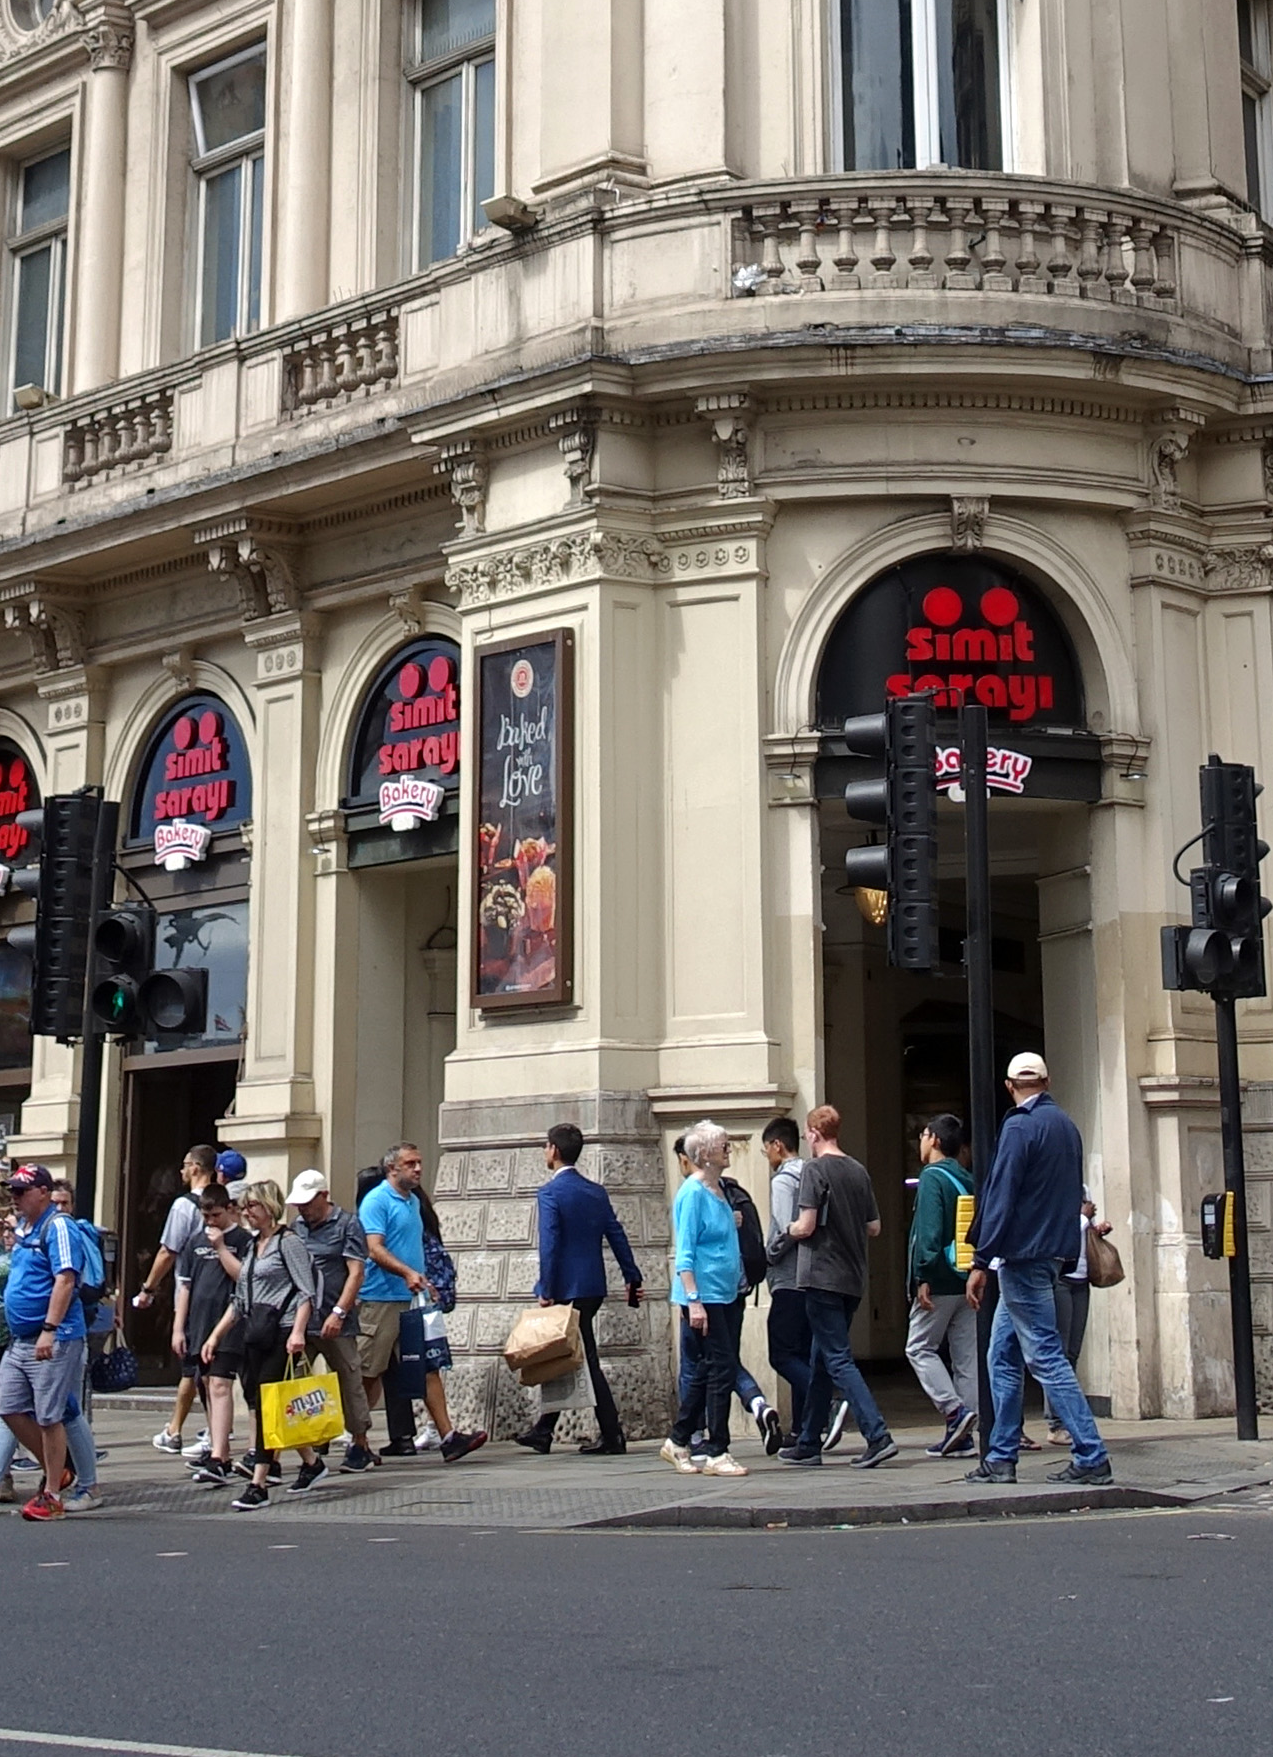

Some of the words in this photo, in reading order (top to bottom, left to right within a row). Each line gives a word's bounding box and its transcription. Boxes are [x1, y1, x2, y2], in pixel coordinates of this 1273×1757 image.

[496, 705, 548, 751] Baked
[498, 755, 543, 809] Love
[933, 747, 1029, 782] aery
[381, 777, 437, 811] Bakery
[156, 822, 204, 851] Bakery
